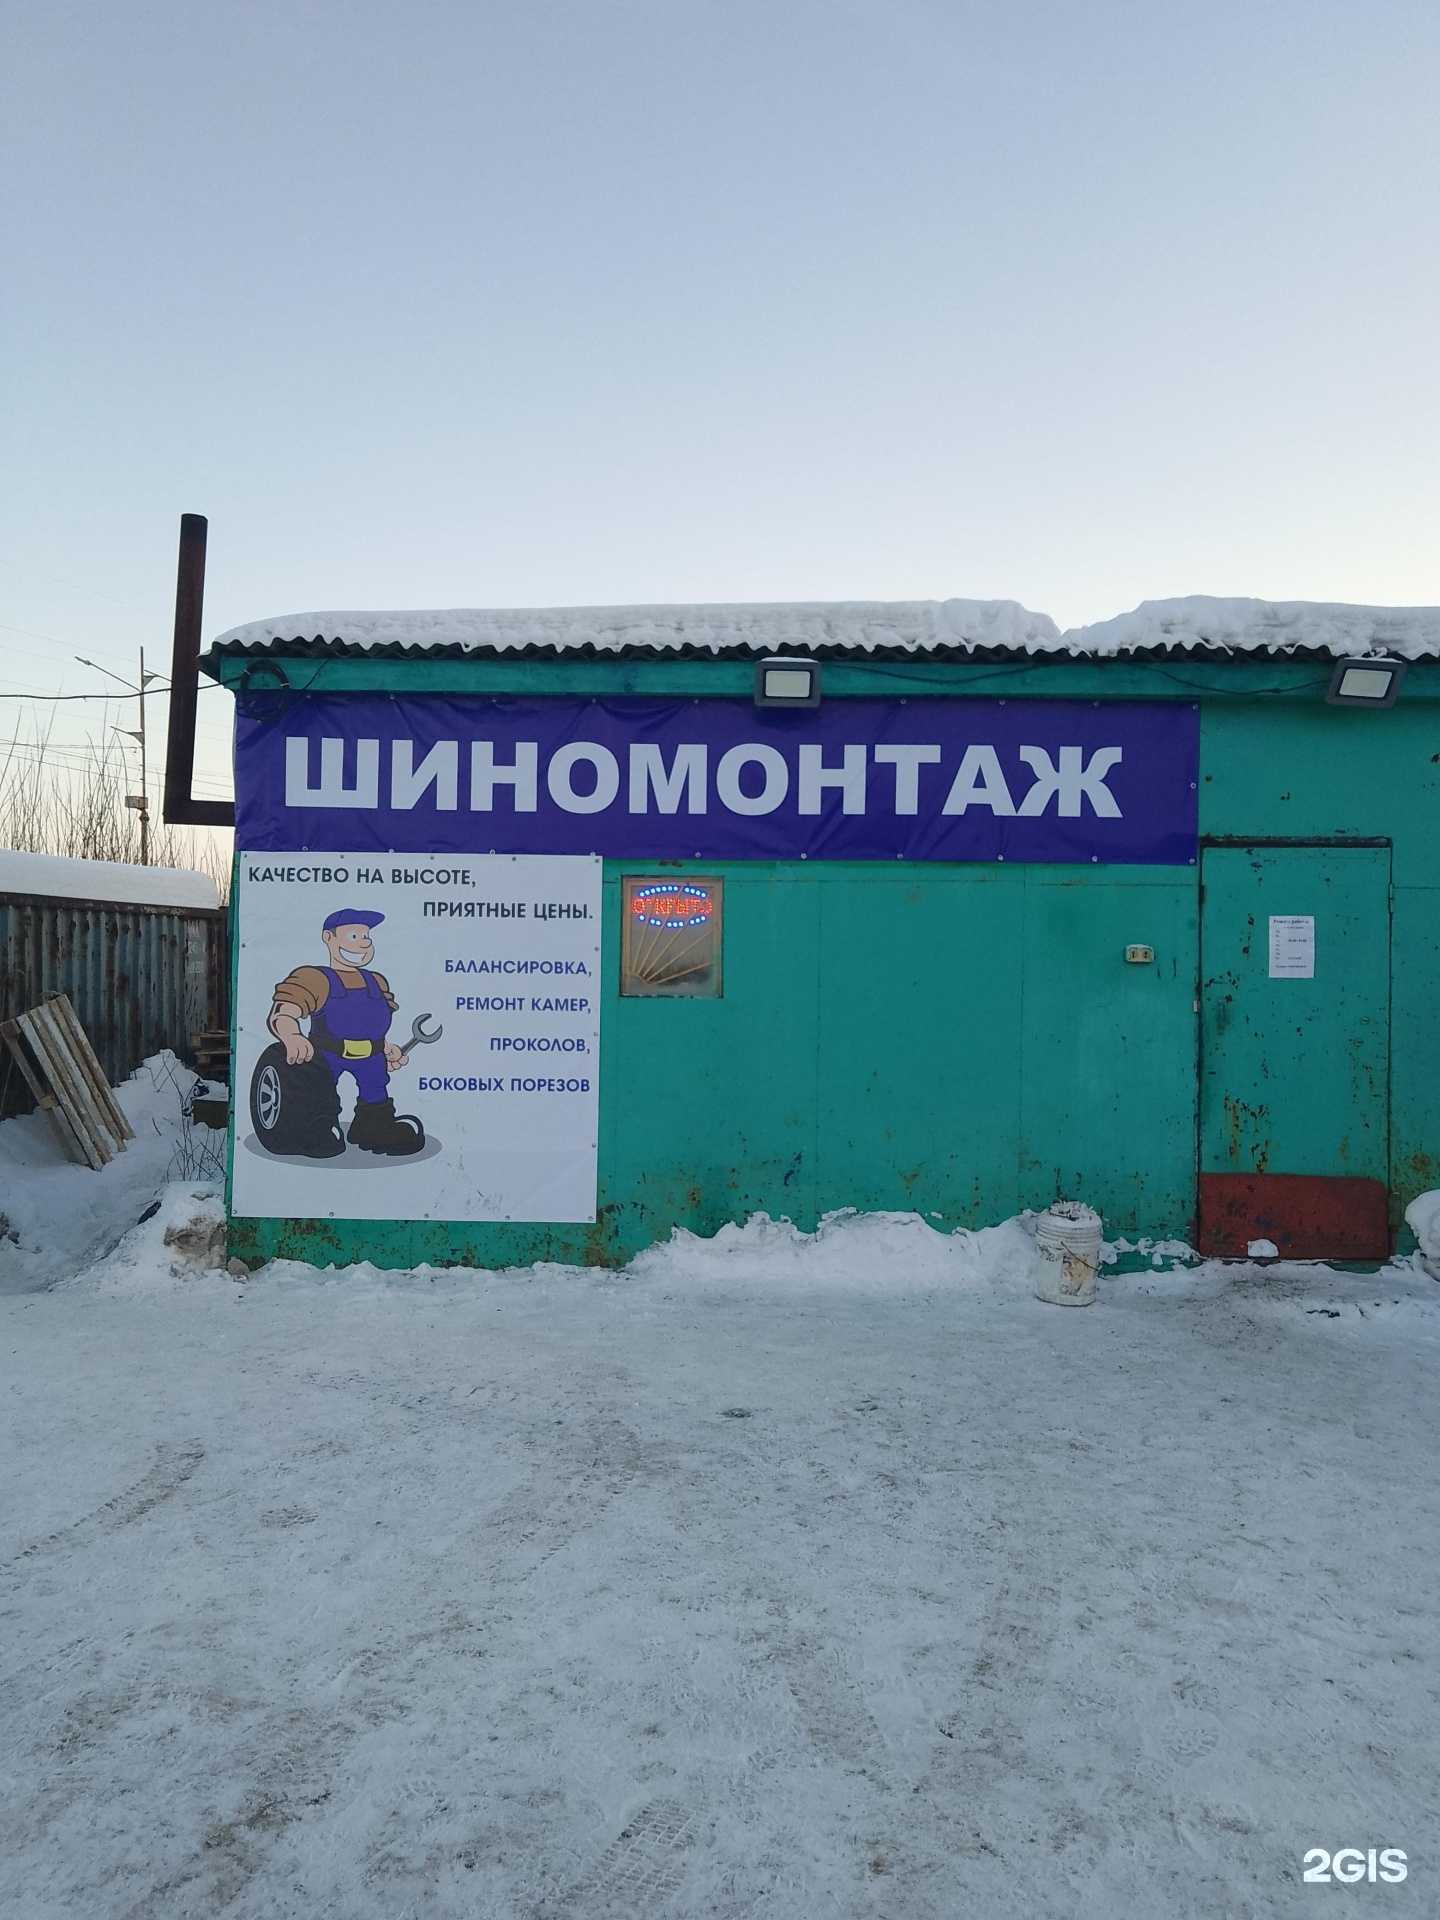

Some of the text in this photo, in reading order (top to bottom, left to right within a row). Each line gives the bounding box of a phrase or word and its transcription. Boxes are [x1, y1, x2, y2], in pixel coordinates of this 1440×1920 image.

[285, 736, 1124, 819] ШИНОМОНТАЖ
[248, 866, 477, 888] КАЧЕСТВО НА ВЫСОТЕ,
[422, 901, 594, 921] ПРИЯТНЫЕ ЦЕНЫ.
[444, 959, 592, 977] БАЛАНСИРОВКА,
[456, 996, 592, 1014] РЕМОНТ КАМЕР,
[490, 1037, 591, 1054] ПРОКОЛОВ,
[418, 1076, 590, 1093] БОКОВЫХ ПОРЕЗОВ
